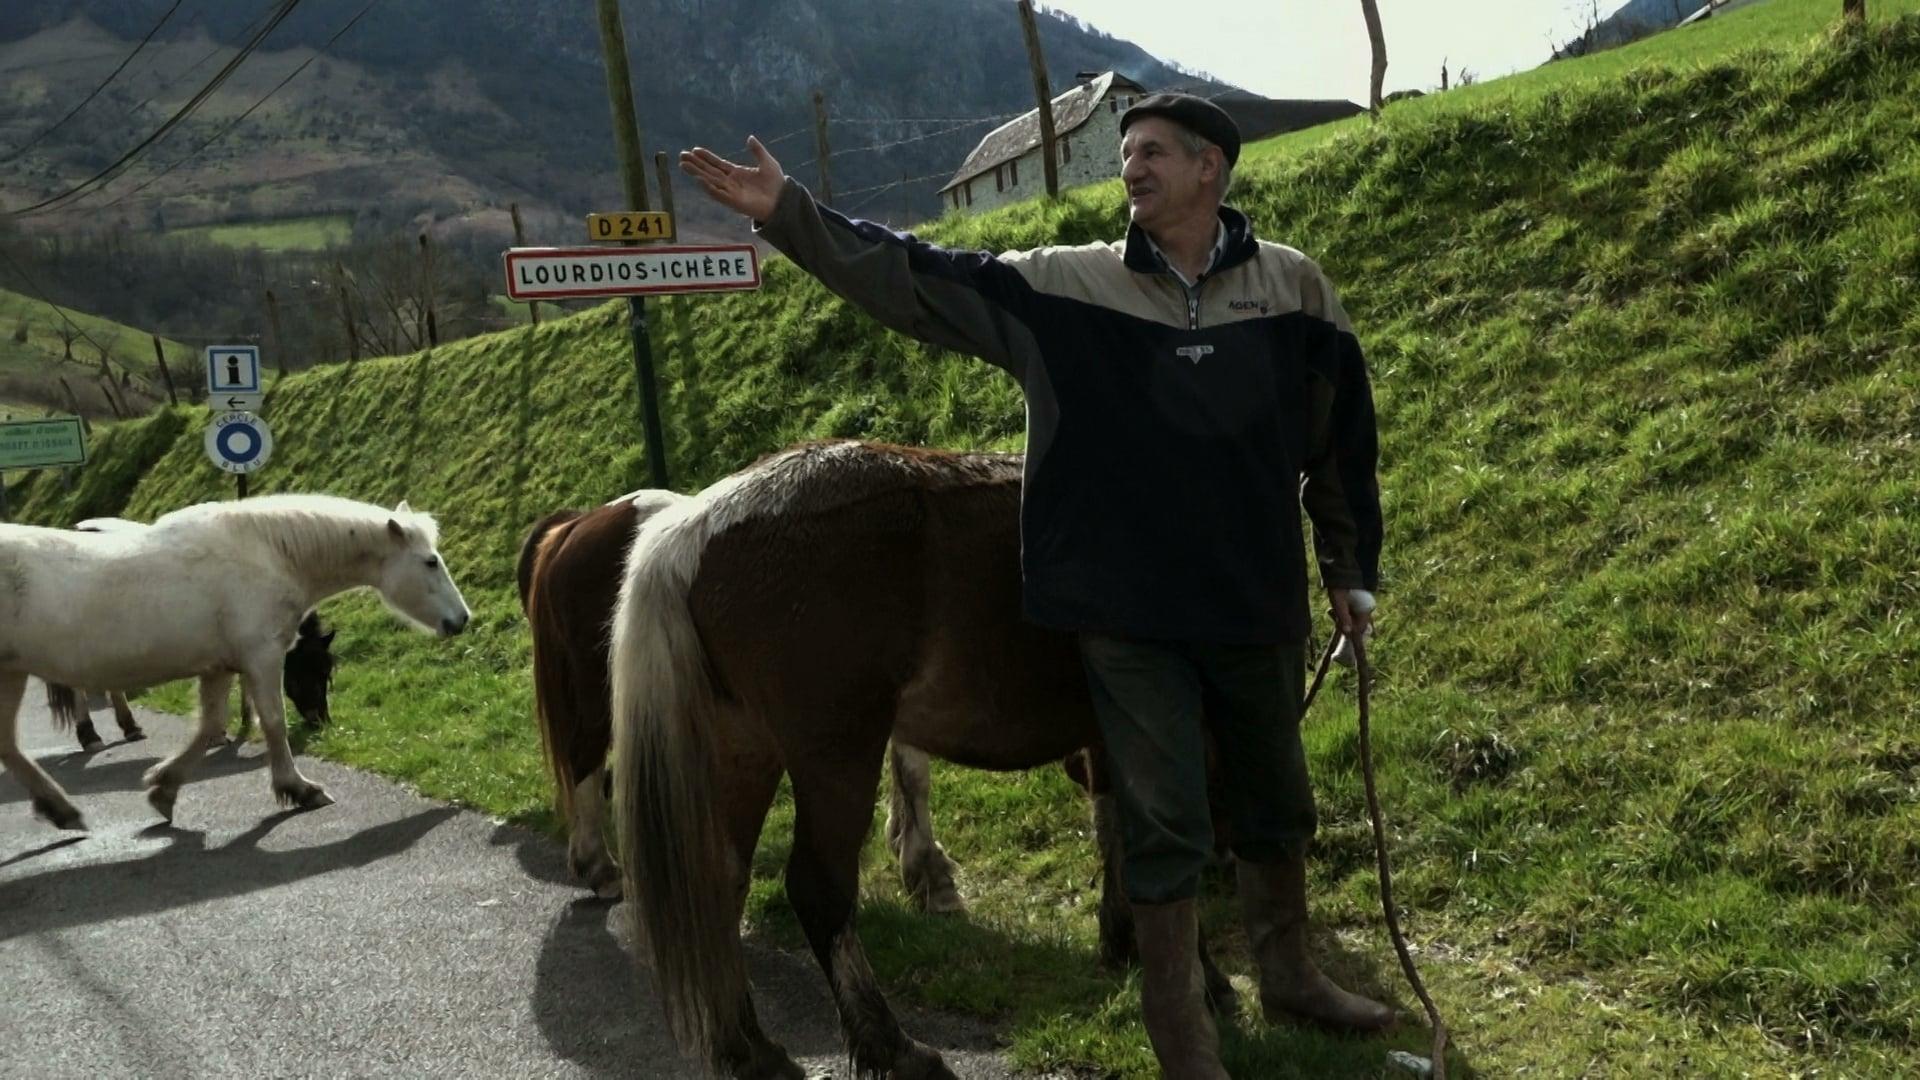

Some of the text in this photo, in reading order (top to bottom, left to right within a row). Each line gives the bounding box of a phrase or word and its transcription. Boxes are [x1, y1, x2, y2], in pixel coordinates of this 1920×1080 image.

[599, 217, 664, 236] D 241
[521, 256, 746, 284] LOURDIOS-ICHÈRE
[217, 412, 257, 428] CERCLE
[221, 457, 262, 472] BLEU
